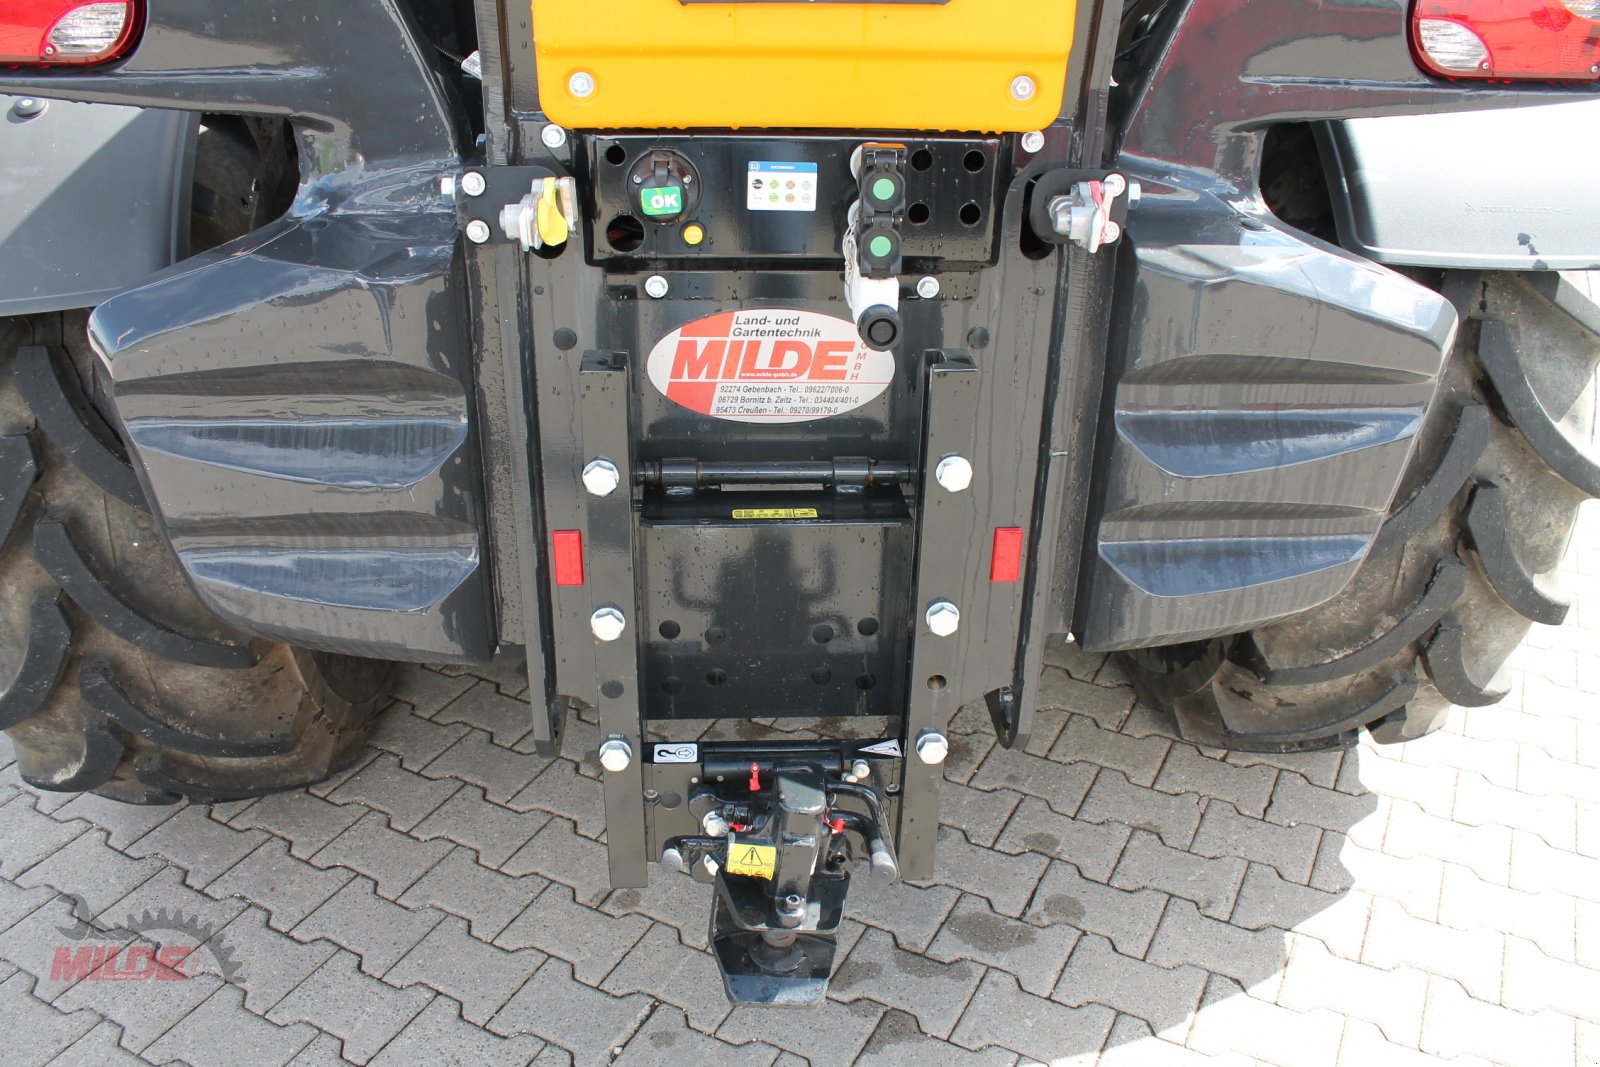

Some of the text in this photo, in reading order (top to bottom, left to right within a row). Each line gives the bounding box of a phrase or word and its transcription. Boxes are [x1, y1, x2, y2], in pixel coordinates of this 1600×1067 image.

[651, 193, 679, 209] OK
[735, 315, 800, 326] Land- und
[732, 327, 822, 338] Gartentechnik
[669, 340, 856, 380] MILDE
[741, 371, 798, 379] www.milde-gmbh.de
[720, 385, 741, 393] 92274
[742, 385, 782, 393] Gebenbach
[804, 385, 850, 394] 09622/7006-0
[717, 396, 739, 404] 06729
[740, 396, 765, 404] Bornitz
[766, 396, 774, 404] b.
[775, 396, 792, 404] Zeitz
[814, 396, 859, 404] 034424/401-0
[715, 406, 736, 414] 95473
[737, 406, 767, 414] Creußen
[789, 406, 838, 414] 09270/99179-0
